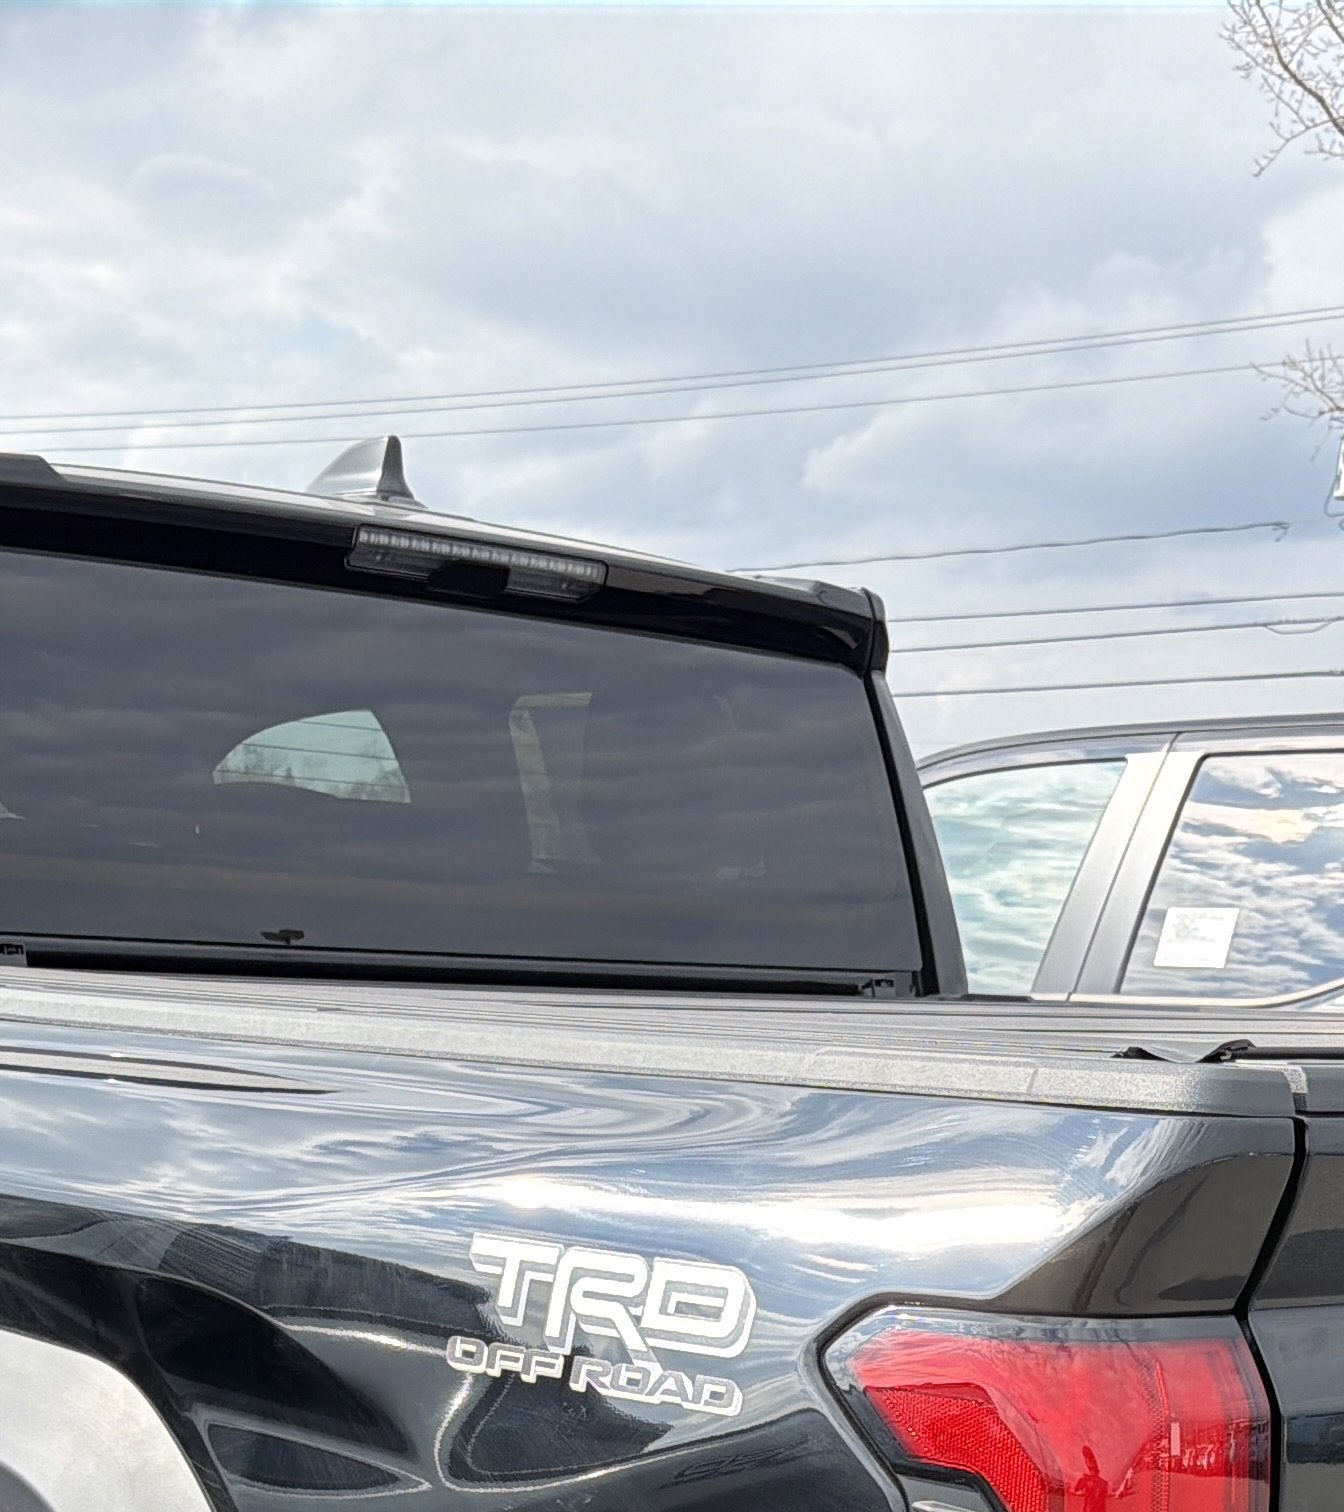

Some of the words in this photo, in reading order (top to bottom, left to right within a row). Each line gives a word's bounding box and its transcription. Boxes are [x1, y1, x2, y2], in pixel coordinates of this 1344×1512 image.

[469, 1231, 756, 1368] TRD
[446, 1335, 564, 1383] OFF
[568, 1355, 743, 1416] ROAD
